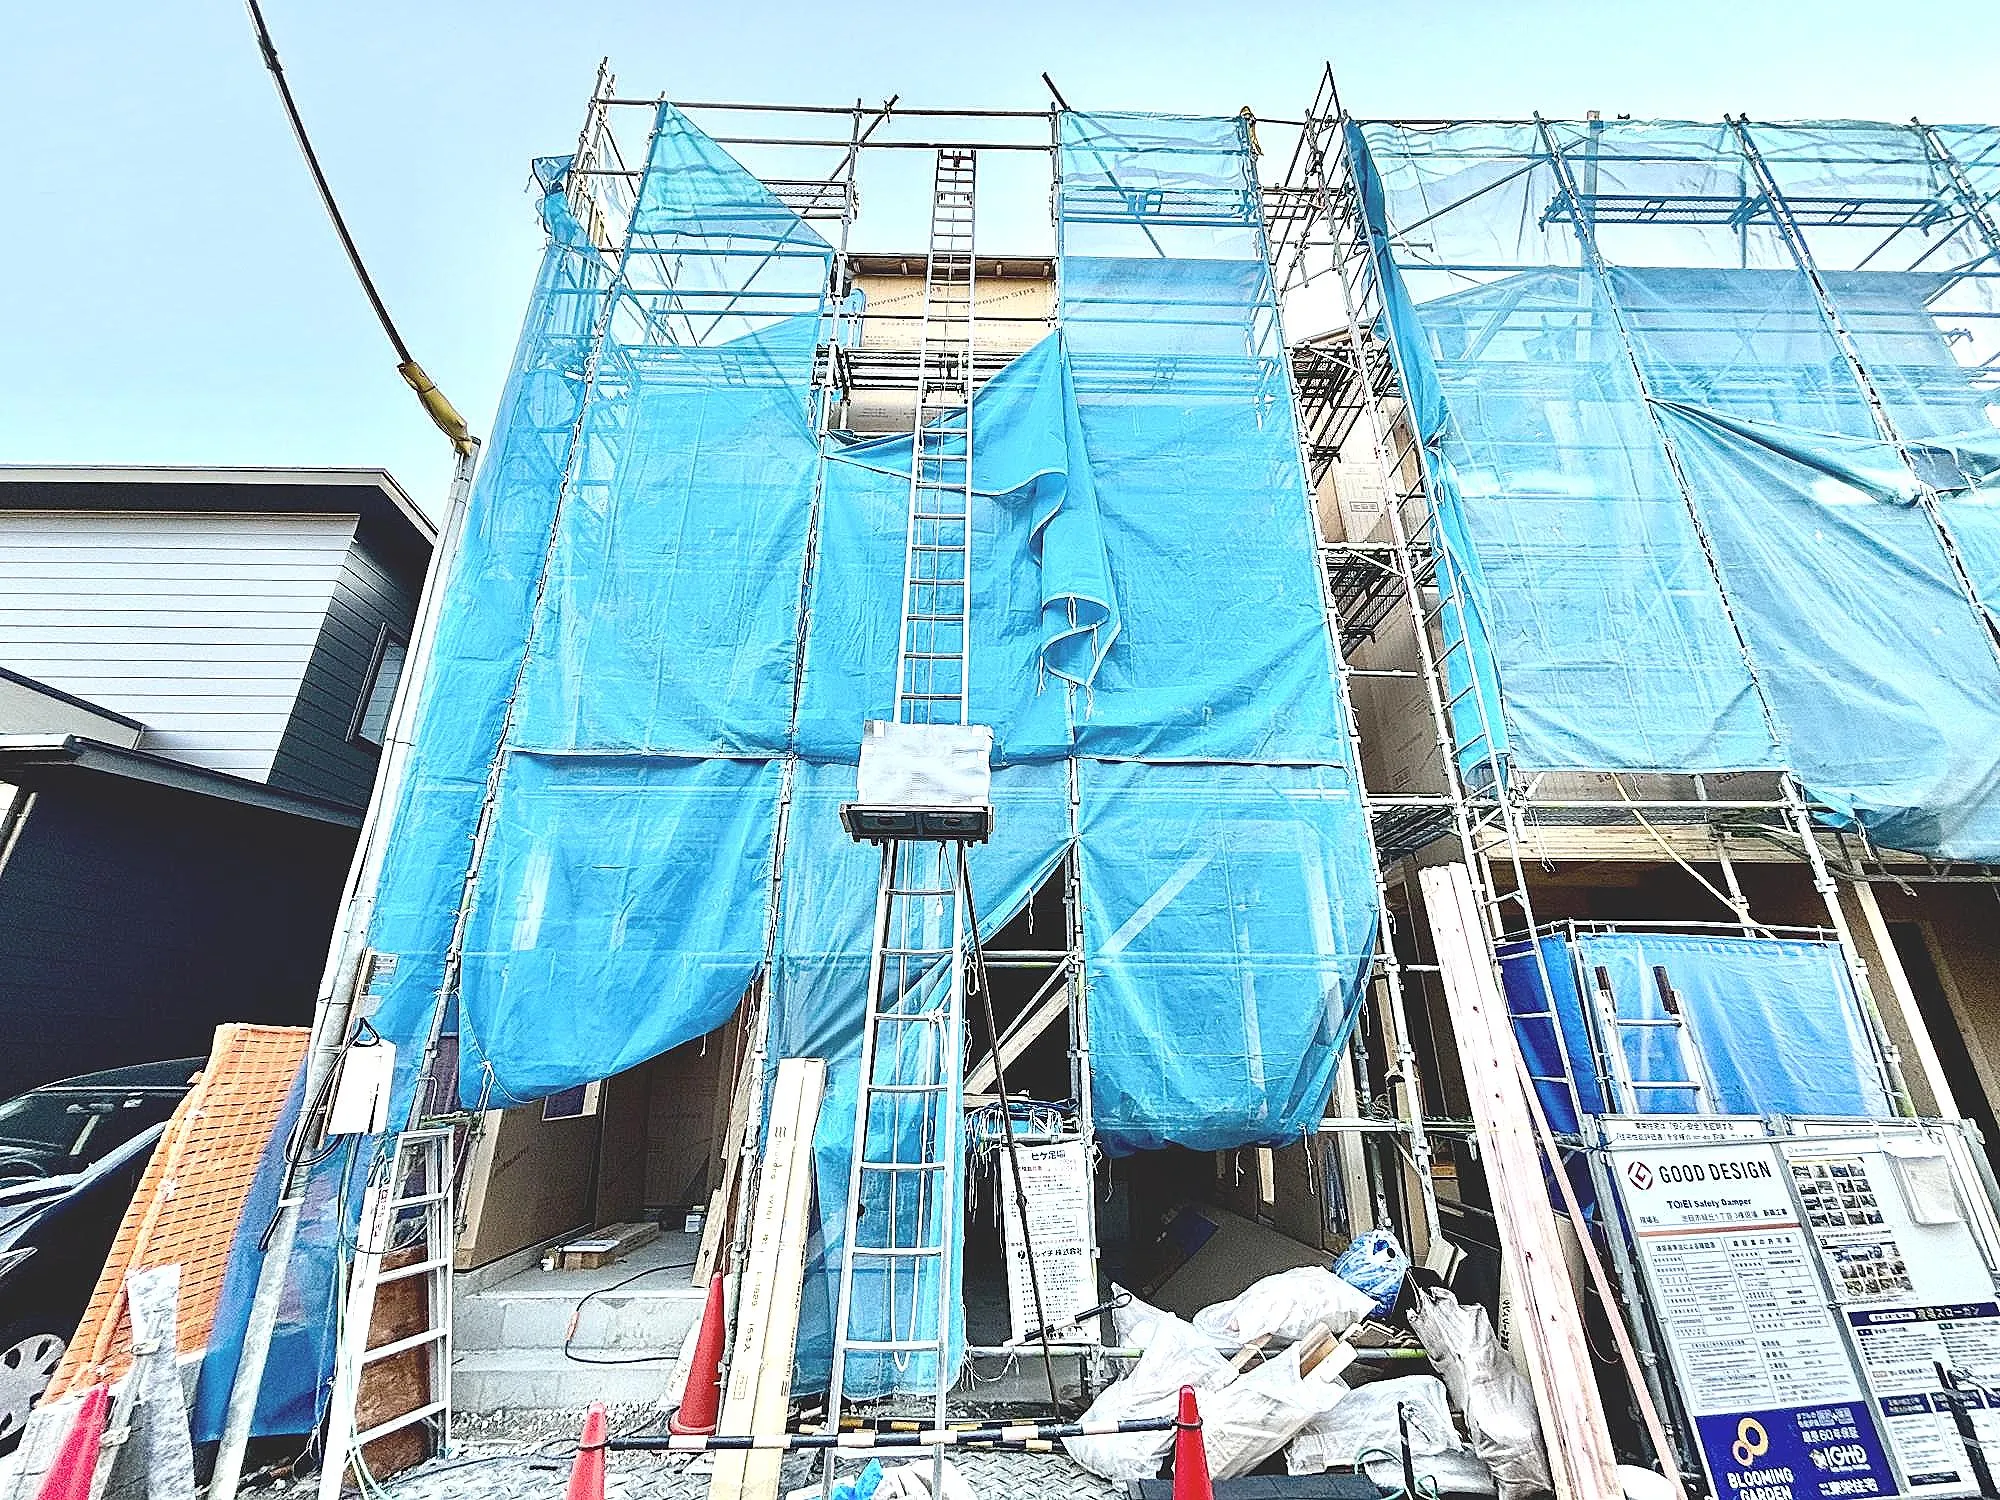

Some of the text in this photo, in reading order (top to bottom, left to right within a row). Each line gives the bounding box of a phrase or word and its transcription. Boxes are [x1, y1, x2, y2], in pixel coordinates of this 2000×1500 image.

[1658, 1160, 1772, 1184] GOOD DESIGN
[1694, 1199, 1720, 1209] Safety
[1726, 1467, 1794, 1489] BLOOMING
[1739, 1485, 1794, 1500] GARDEN
